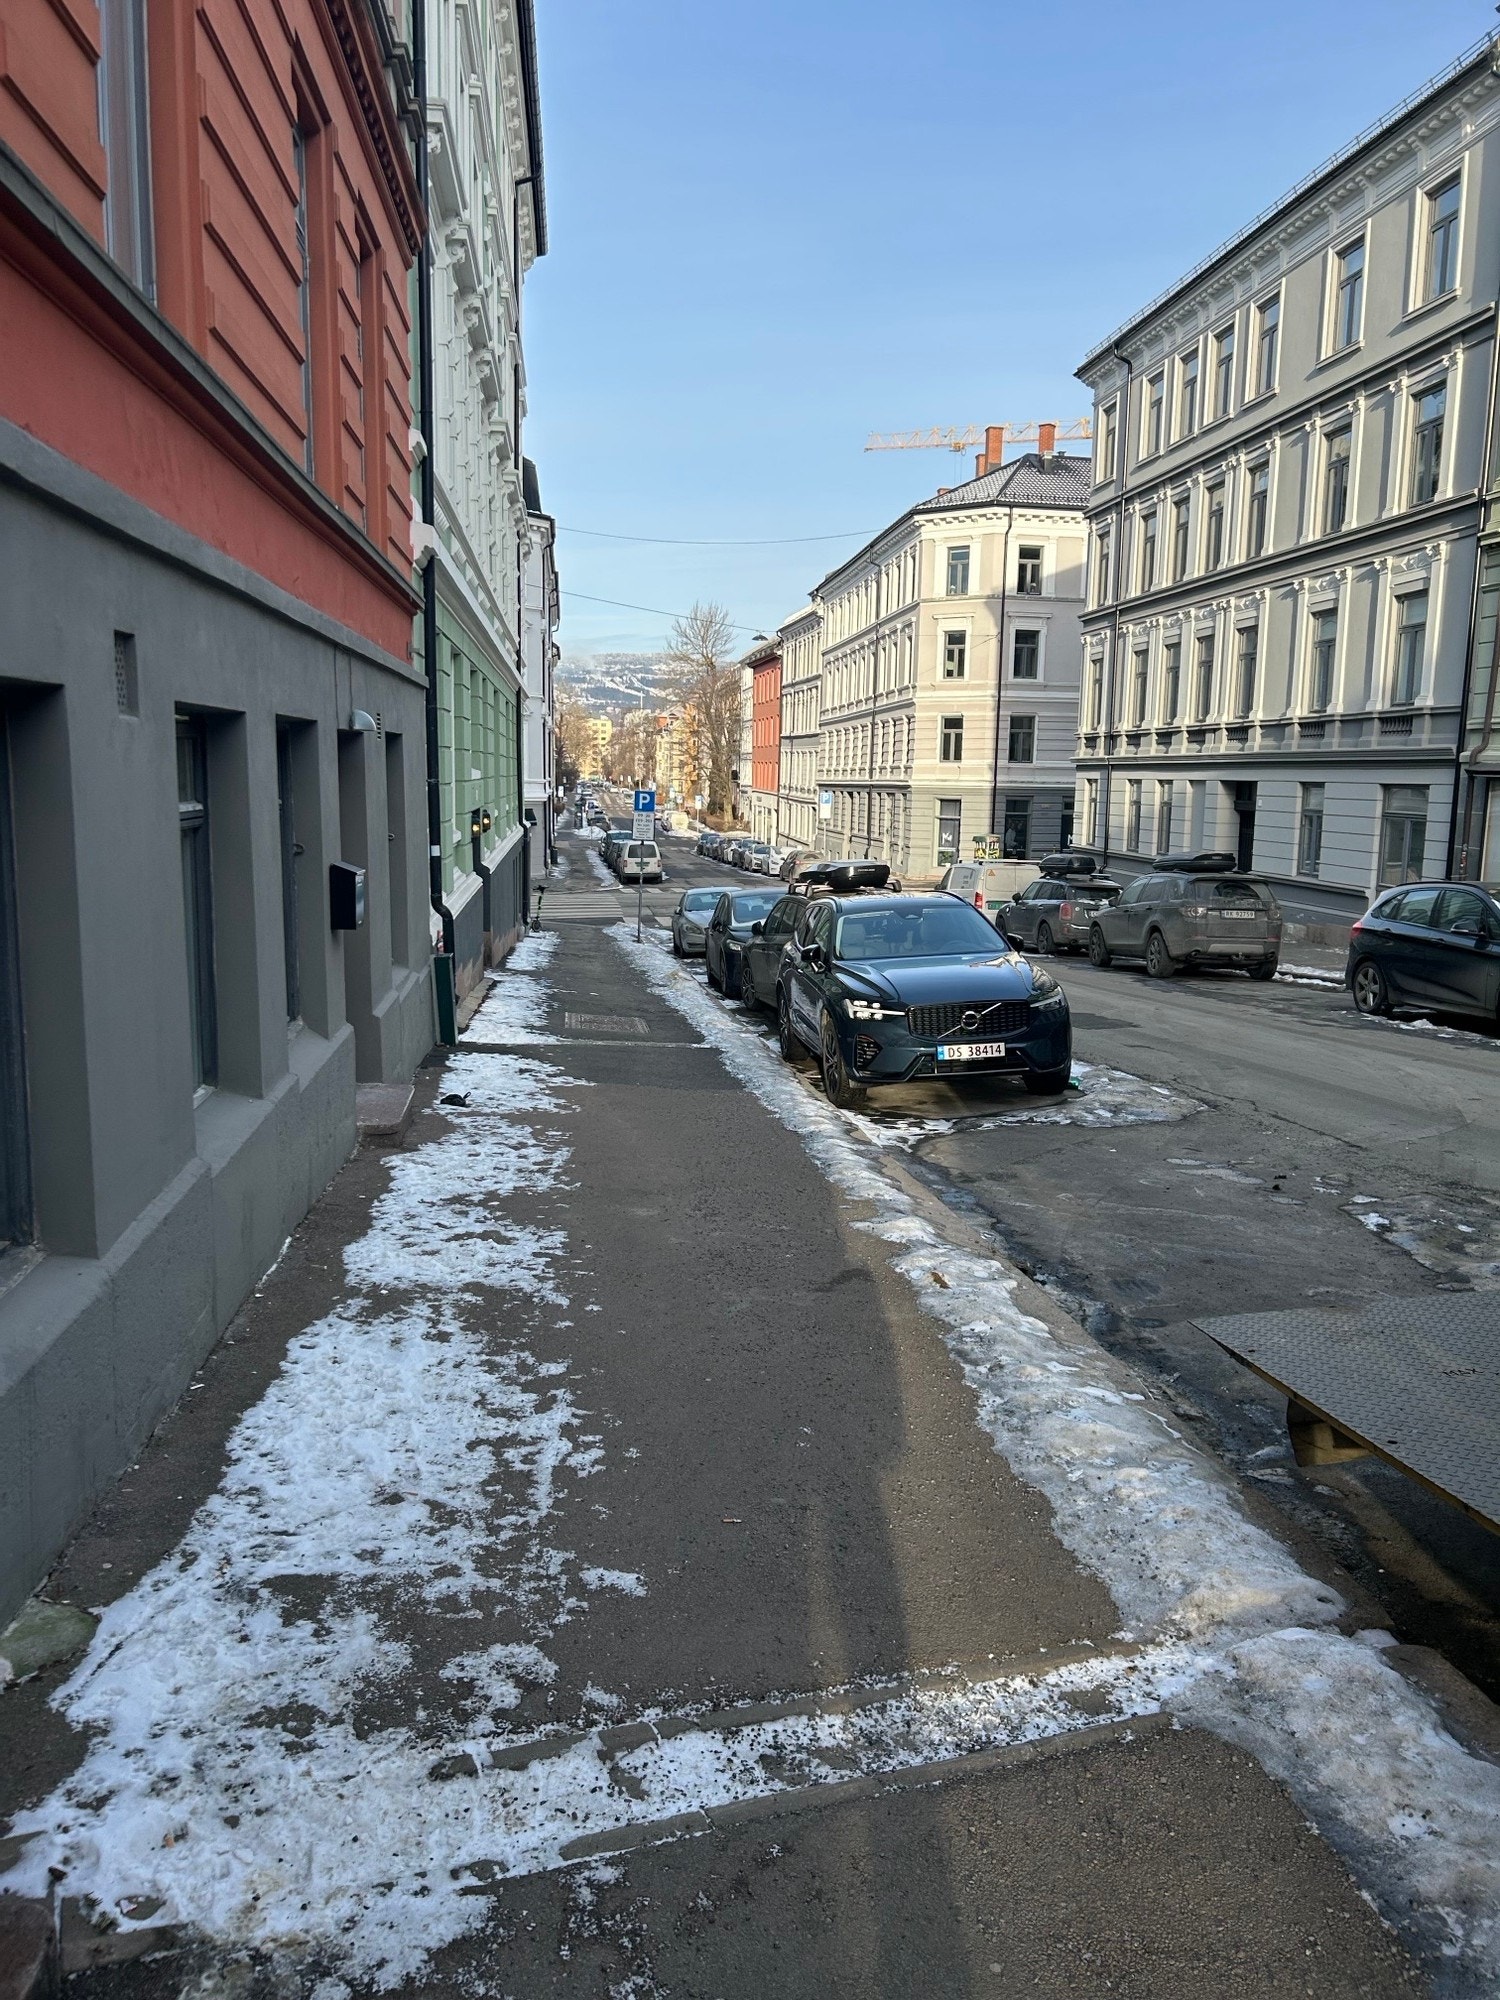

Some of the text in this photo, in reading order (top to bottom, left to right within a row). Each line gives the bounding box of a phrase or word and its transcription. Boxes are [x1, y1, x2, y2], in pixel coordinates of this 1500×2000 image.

[639, 793, 650, 809] P
[822, 793, 830, 803] P
[948, 1044, 1002, 1058] DS 38414
